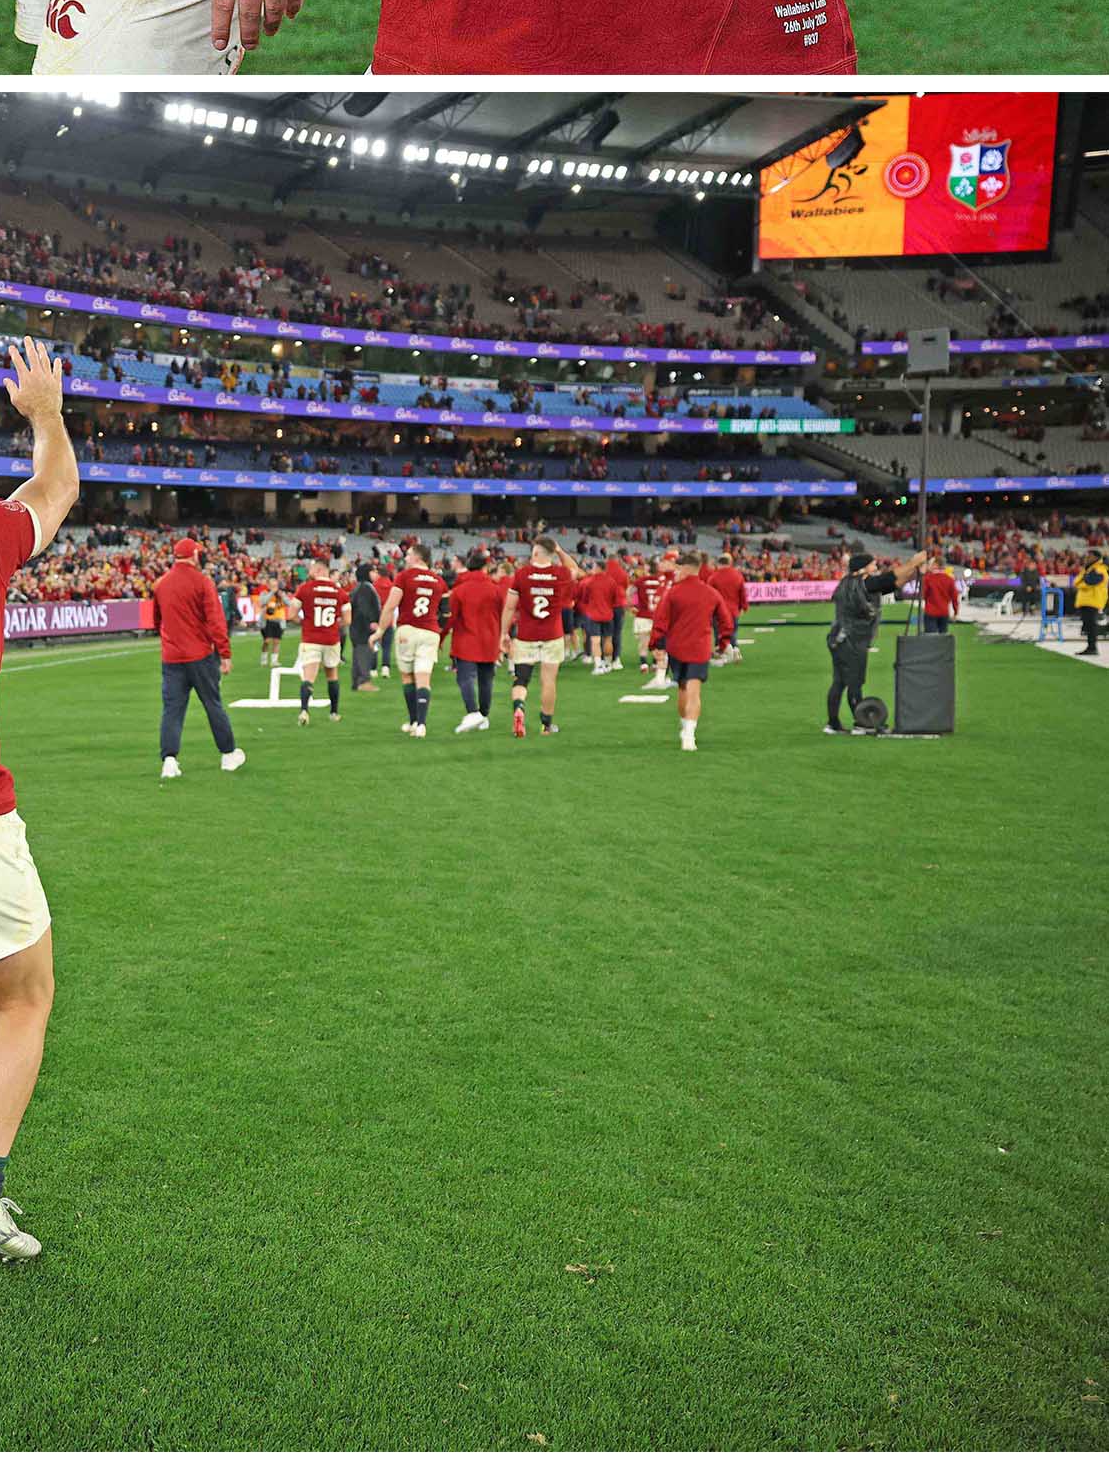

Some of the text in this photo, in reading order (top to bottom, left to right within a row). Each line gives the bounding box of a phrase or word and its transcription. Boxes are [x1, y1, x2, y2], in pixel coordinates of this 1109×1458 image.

[774, 1, 810, 18] Wallabies
[783, 19, 801, 34] 26th
[802, 16, 815, 31] July
[790, 205, 865, 219] Wallabies
[314, 606, 336, 627] 16
[412, 596, 430, 618] 8
[533, 596, 550, 619] 2
[4, 604, 108, 638] QATAR AIRWAYS
